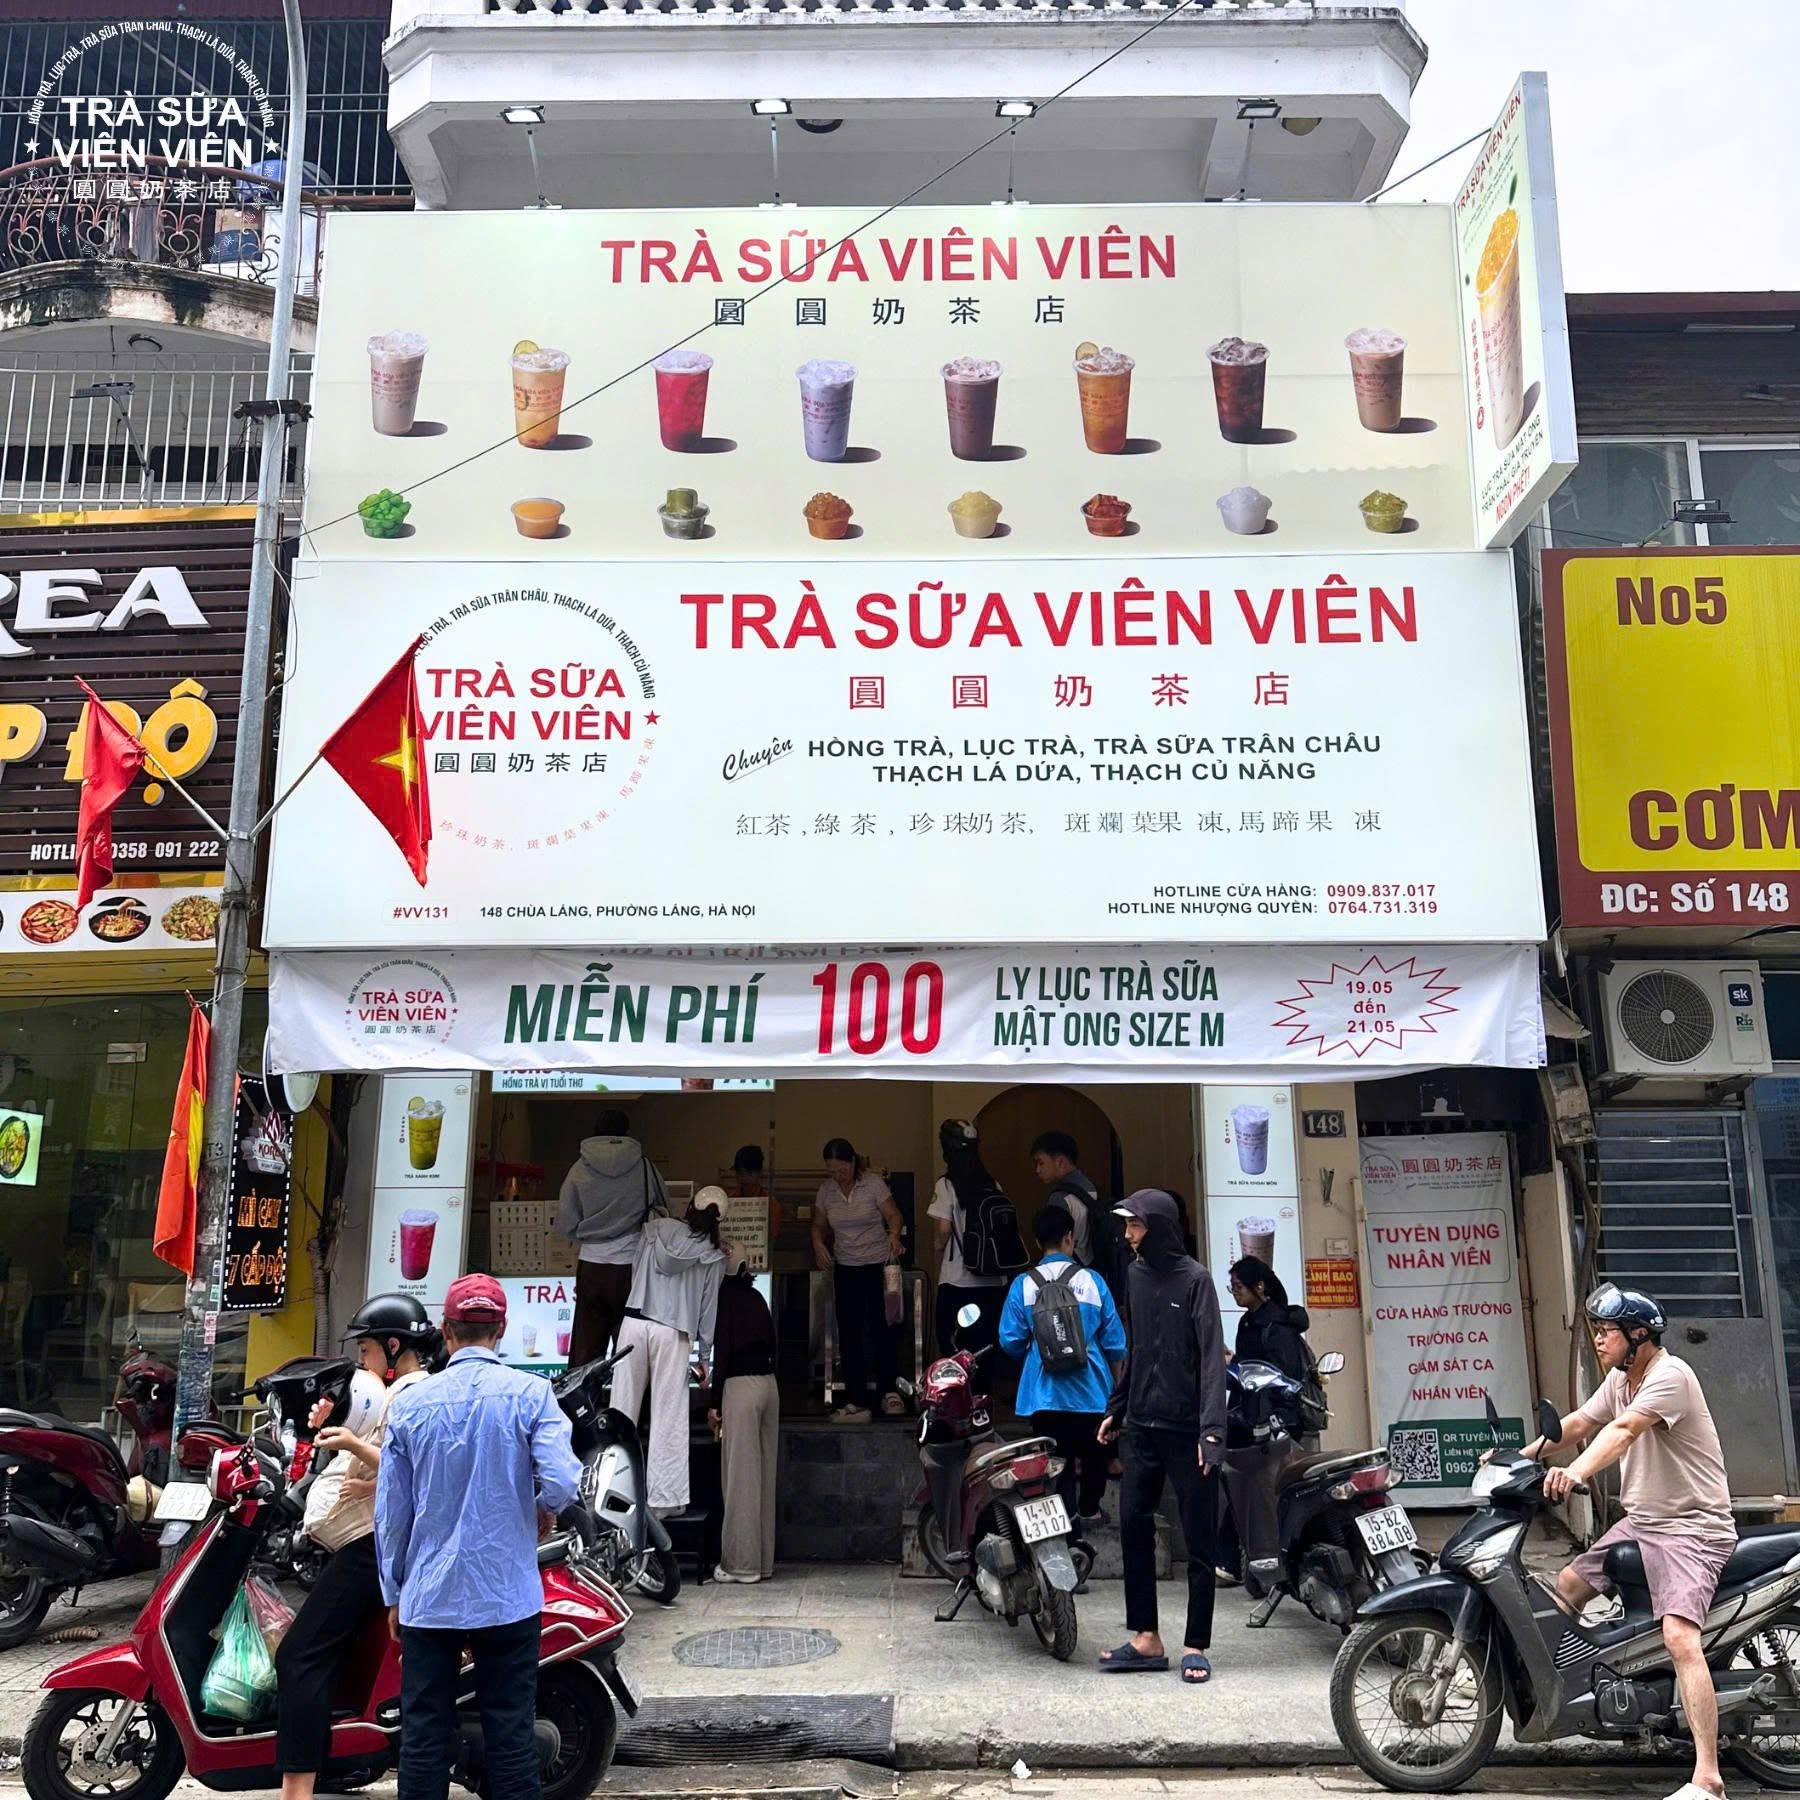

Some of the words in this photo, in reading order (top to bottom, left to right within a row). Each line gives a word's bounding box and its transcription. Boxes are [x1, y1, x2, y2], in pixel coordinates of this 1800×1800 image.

[600, 228, 723, 285] TRÀ
[737, 229, 871, 284] SỮA
[878, 226, 1018, 282] VIÊN
[1035, 224, 1176, 280] VIÊN
[714, 295, 1065, 327] 圓圓奶茶店
[449, 602, 471, 621] TRÀ
[491, 589, 518, 604] TRÂN
[553, 592, 586, 613] THẠCH
[584, 605, 599, 620] LÁ
[680, 580, 837, 650] TRÀ
[854, 580, 1023, 650] SỮA
[1033, 577, 1213, 647] VIÊN
[1233, 573, 1418, 644] VIÊN
[1616, 577, 1728, 625] No5
[426, 661, 515, 698] TRÀ
[529, 662, 626, 698] SỮA
[849, 671, 1290, 710] 圓圓奶茶店
[420, 703, 516, 740] VIÊN
[531, 703, 631, 740] VIÊN
[807, 736, 886, 757] HỒNG
[893, 735, 954, 760] TRÀ,
[963, 738, 1016, 760] LỤC
[1025, 734, 1085, 758] TRÀ,
[1093, 733, 1148, 755] TRÀ
[1156, 734, 1214, 755] SỮA
[1222, 732, 1295, 754] TRÂN
[1304, 732, 1381, 753] CHÂU
[434, 752, 607, 773] 圓圓奶茶店
[722, 737, 795, 782] Chuyên
[873, 764, 963, 787] THẠCH
[973, 761, 1007, 783] LÁ
[1016, 760, 1081, 783] DỨA,
[1090, 763, 1183, 785] THẠCH
[1191, 760, 1229, 781] CỦ
[1238, 761, 1317, 780] NĂNG
[1628, 784, 1800, 850] CƠM
[155, 841, 182, 859] 091
[189, 840, 219, 858] 222
[1153, 885, 1222, 898] HOTLINE
[1226, 883, 1263, 898] CỬA
[1266, 882, 1317, 897] HÀNG:
[1327, 884, 1436, 898] 0909.837.017
[1601, 884, 1659, 913] ĐC:
[1671, 878, 1717, 912] Số
[1726, 883, 1790, 912] 148
[393, 906, 449, 920] #VV131
[480, 906, 502, 919] 148
[506, 903, 547, 918] CHÙA
[549, 903, 593, 920] LÁNG,
[596, 902, 659, 918] PHƯỜNG
[662, 902, 705, 919] LÁNG,
[708, 903, 728, 917] HÀ
[731, 902, 756, 919] NỘI
[1108, 902, 1176, 915] HOTLINE
[1181, 901, 1253, 917] NHƯỢNG
[1257, 899, 1318, 915] QUYỀN:
[1328, 900, 1438, 915] 0764.731.319
[996, 966, 1033, 1001] LY
[1038, 968, 1092, 1008] LỤC
[1099, 960, 1153, 1000] TRÀ
[1162, 959, 1219, 1000] SỮA
[1345, 981, 1393, 995] 19.05
[1733, 988, 1748, 999] sk
[362, 988, 399, 1005] TRÀ
[404, 988, 444, 1004] SỮA
[1353, 998, 1387, 1015] đến
[358, 1006, 399, 1022] VIÊN
[405, 1005, 447, 1021] VIÊN
[504, 962, 650, 1044] MIỄN
[664, 974, 758, 1044] PHÍ
[811, 960, 946, 1057] 100
[993, 1009, 1051, 1053] MẬT
[1063, 1012, 1121, 1047] ONG
[1129, 1012, 1189, 1047] SIZE
[1199, 1012, 1225, 1047] M
[1347, 1020, 1396, 1035] 21.05
[1307, 1115, 1340, 1134] 148
[1373, 1223, 1440, 1243] TUYỂN
[1447, 1223, 1500, 1244] DỤNG
[1387, 1249, 1445, 1269] NHÂN
[1450, 1247, 1491, 1267] VIÊN
[524, 1281, 567, 1304] TRÀ
[1376, 1304, 1409, 1320] CỬA
[1412, 1304, 1449, 1319] HÀNG
[1452, 1303, 1512, 1316] TRƯỞNG
[1468, 1331, 1489, 1343] CA
[1443, 1358, 1469, 1372] SÁT
[1473, 1359, 1494, 1371] CA
[1412, 1385, 1451, 1400] NHÂN
[1455, 1384, 1487, 1399] VIÊN
[1443, 1434, 1457, 1442] QR
[1368, 1525, 1413, 1551] 384.08
